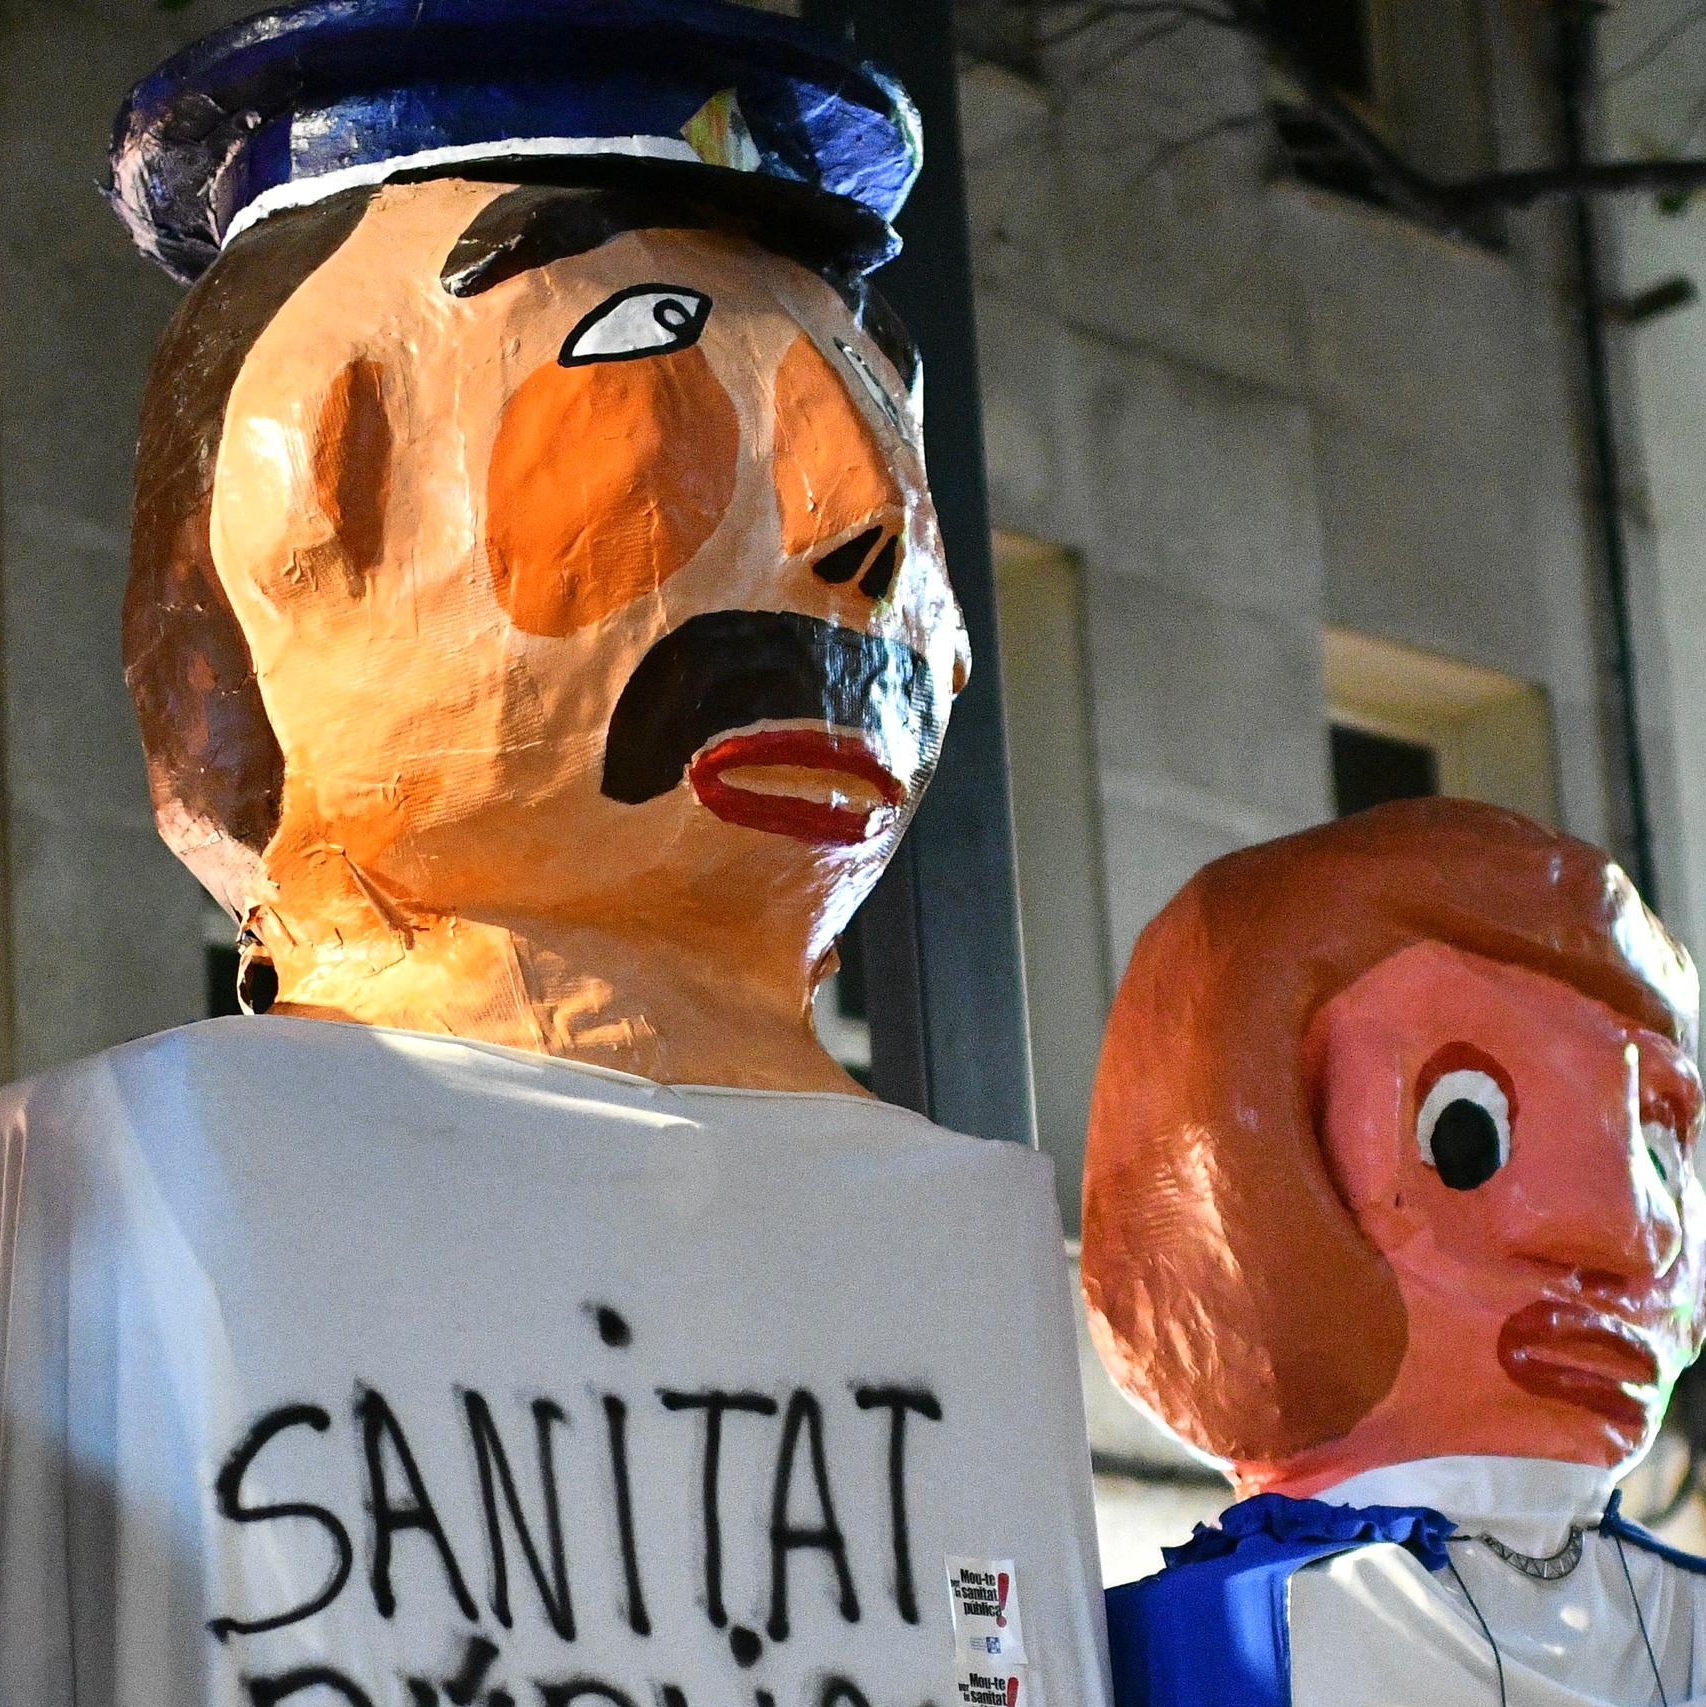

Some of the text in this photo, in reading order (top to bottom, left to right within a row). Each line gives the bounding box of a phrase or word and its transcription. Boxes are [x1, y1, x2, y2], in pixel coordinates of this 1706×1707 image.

[960, 1568, 996, 1586] Mou-te
[961, 1586, 998, 1601] sanitat
[969, 1672, 1006, 1690] Mou-te
[970, 1690, 1008, 1706] sanitat
